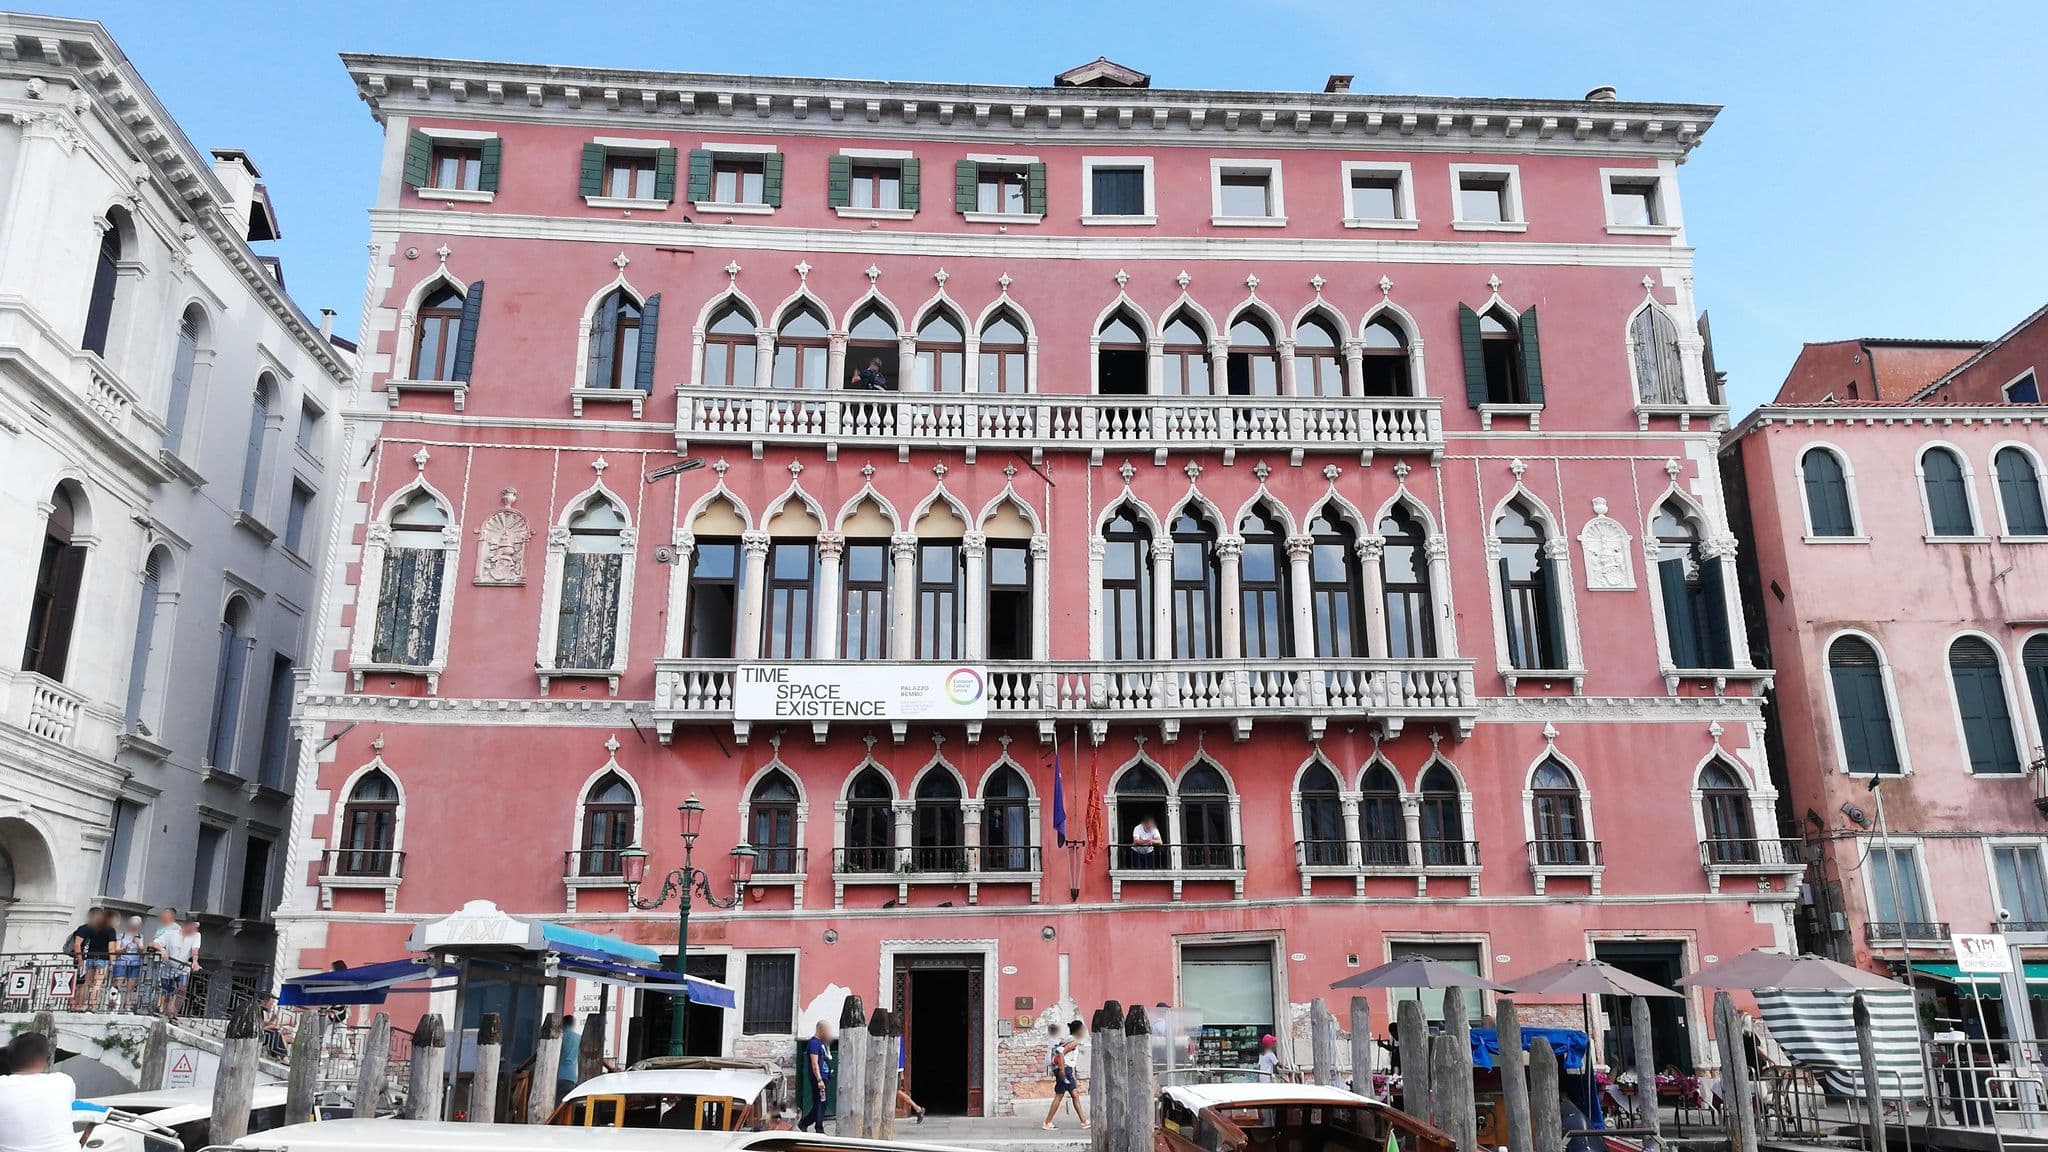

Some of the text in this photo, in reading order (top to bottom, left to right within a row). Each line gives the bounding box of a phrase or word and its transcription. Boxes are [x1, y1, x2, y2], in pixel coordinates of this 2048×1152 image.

[741, 667, 789, 683] TIME
[776, 684, 841, 700] SPACE
[775, 700, 886, 716] EXISTENCE
[1757, 881, 1771, 889] WC
[447, 920, 509, 941] TAXI
[16, 976, 25, 989] 5
